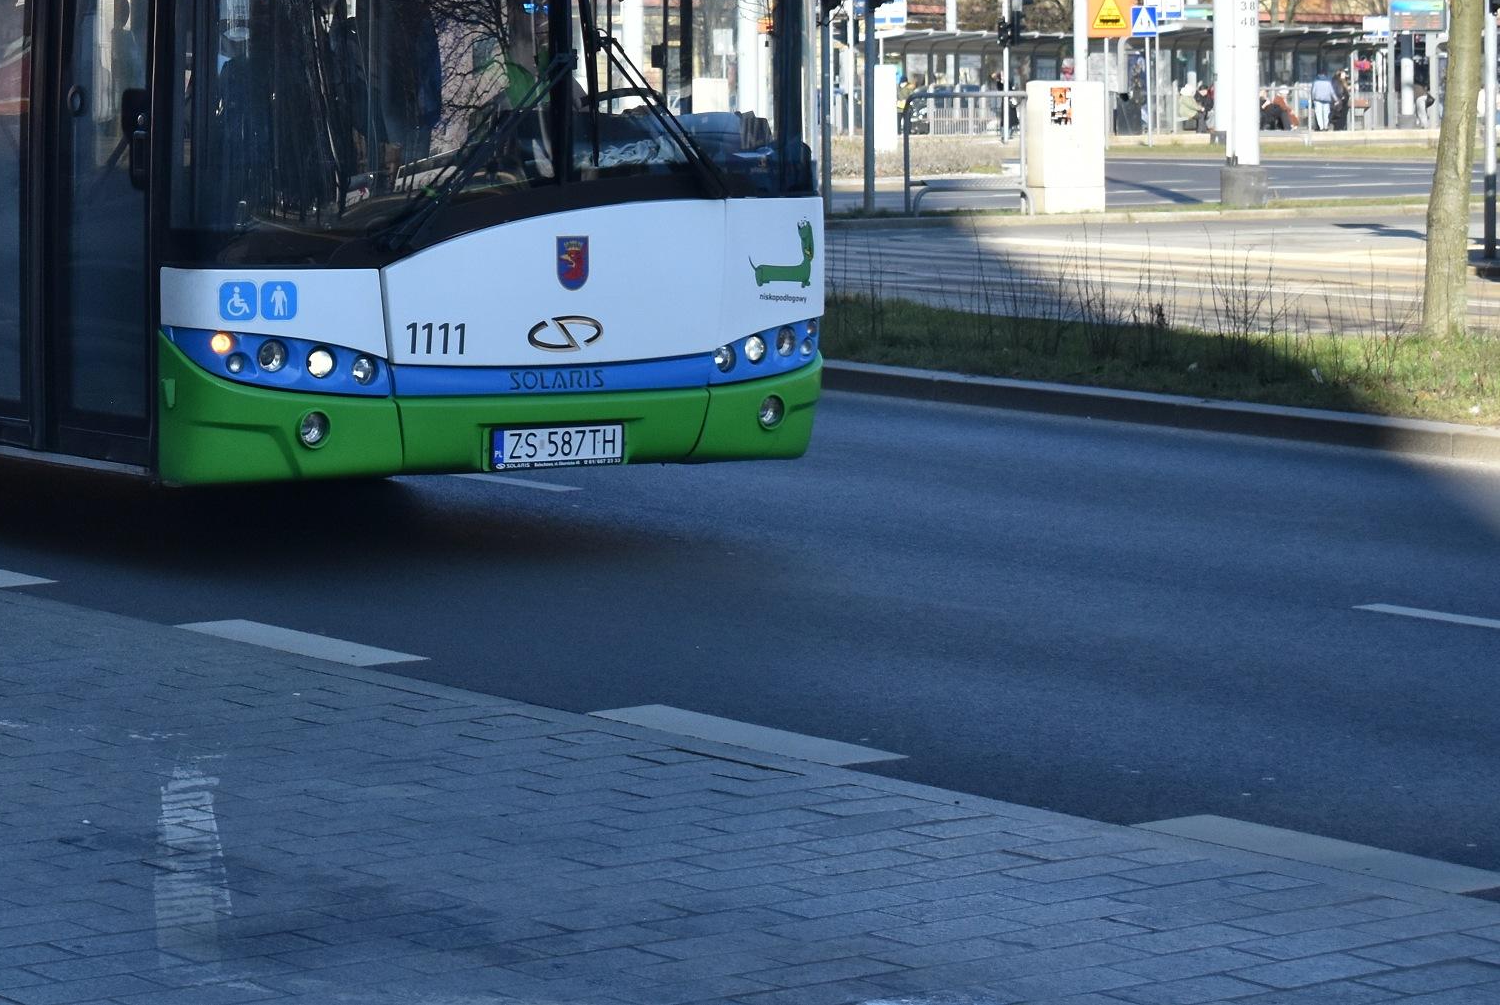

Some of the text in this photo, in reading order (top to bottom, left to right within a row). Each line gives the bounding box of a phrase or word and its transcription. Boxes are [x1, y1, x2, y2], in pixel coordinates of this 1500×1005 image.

[406, 322, 466, 355] 1111
[509, 369, 605, 391] SOLARIS
[509, 428, 616, 459] ZS 587TH
